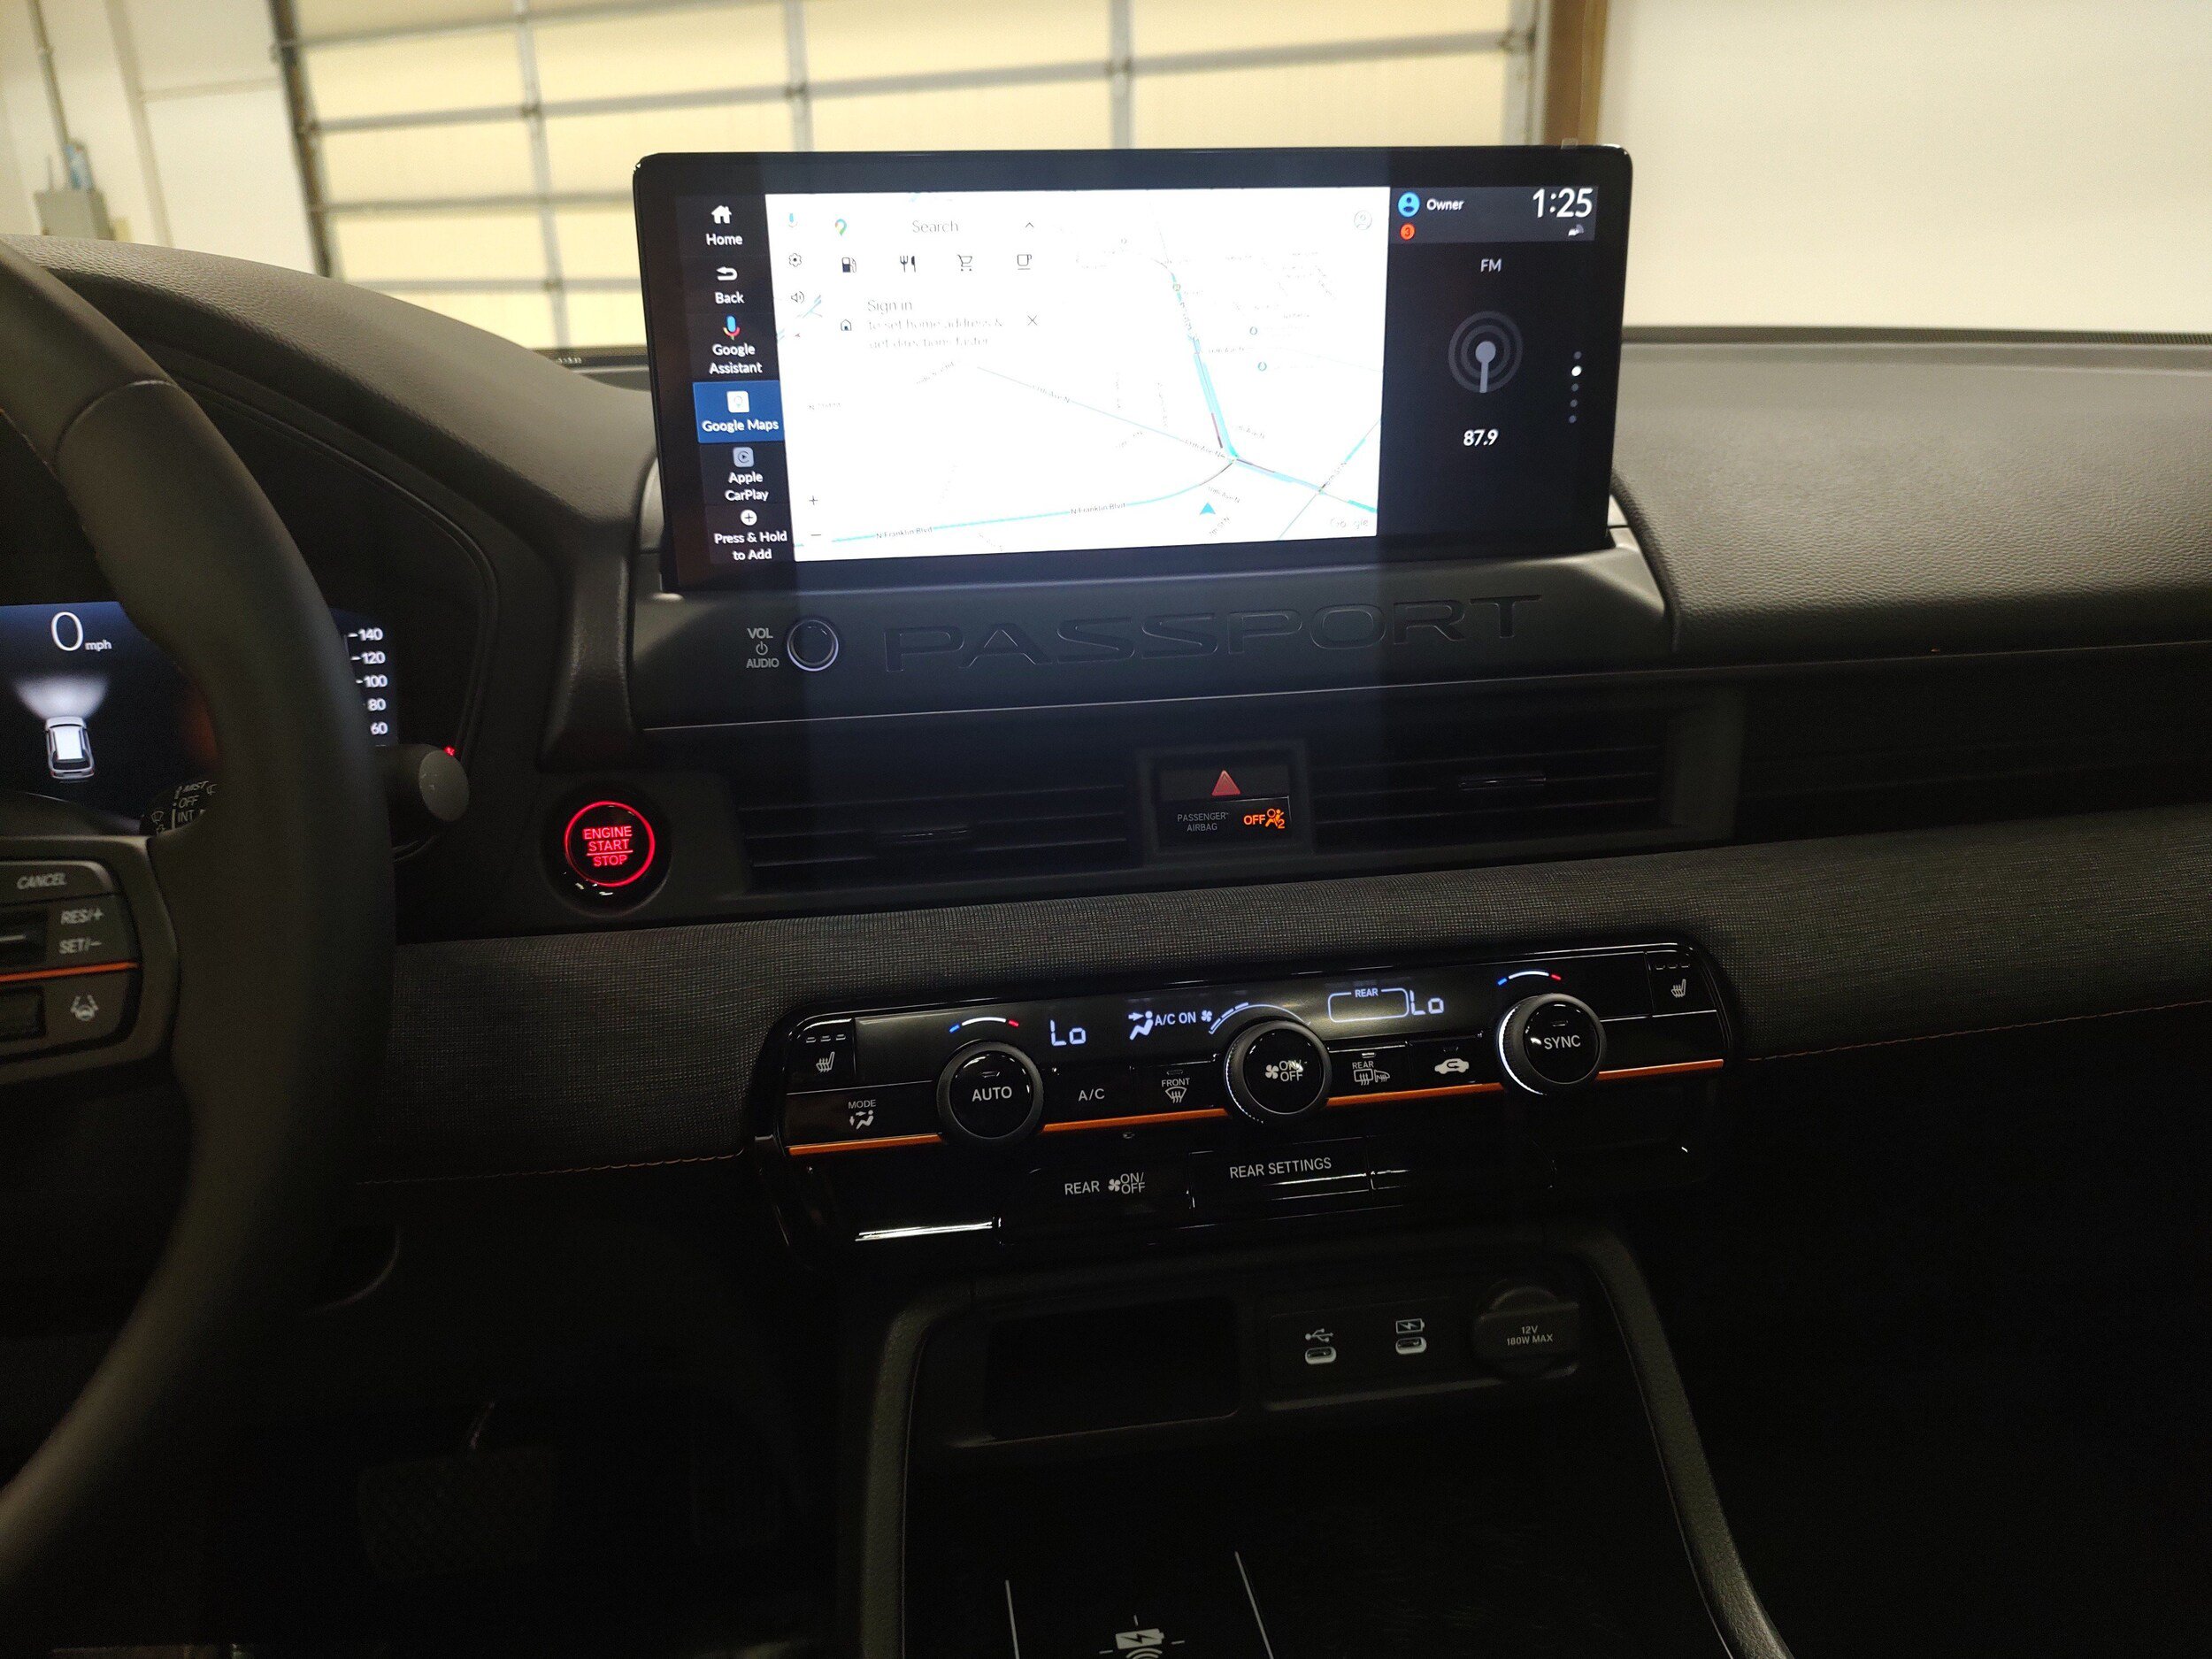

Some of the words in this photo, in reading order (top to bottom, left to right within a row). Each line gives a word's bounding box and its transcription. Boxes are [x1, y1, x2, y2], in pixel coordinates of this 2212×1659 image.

[1426, 198, 1466, 212] Owner
[1532, 187, 1594, 219] 1:25
[912, 219, 959, 234] Search
[705, 233, 743, 246] Home
[1479, 258, 1502, 273] FM
[714, 291, 745, 304] Back
[867, 298, 898, 314] Sign
[901, 299, 913, 311] in
[712, 342, 756, 357] Google
[709, 361, 763, 375] Assistant
[702, 419, 745, 433] Google
[747, 419, 780, 432] Maps
[1463, 428, 1499, 446] 87.9
[728, 471, 764, 484] Apple
[725, 489, 769, 503] CarPlay
[714, 533, 745, 544] Press
[746, 533, 757, 543] &
[759, 530, 787, 542] Hold
[884, 528, 915, 538] Franklin
[732, 549, 745, 560] to
[748, 549, 772, 560] Add
[50, 611, 84, 652] 0
[84, 638, 112, 652] mph
[358, 626, 384, 641] 140
[746, 626, 774, 639] VOL
[883, 594, 1542, 673] PASSPORT
[361, 651, 387, 664] 120
[746, 657, 780, 670] AUDIO
[363, 674, 388, 688] 100
[367, 697, 387, 711] 80
[370, 721, 388, 735] 60
[178, 795, 201, 810] OFF
[177, 809, 196, 824] INT
[1177, 810, 1228, 823] PASSENGER
[1242, 812, 1267, 826] OFF
[582, 825, 634, 841] ENGINE
[1187, 823, 1218, 833] AIRBAG
[588, 838, 630, 853] START
[592, 853, 628, 868] STOP
[16, 872, 67, 890] CANCEL
[1354, 987, 1379, 999] REAR
[1409, 988, 1445, 1017] Lo
[1154, 1013, 1176, 1026] A/C
[1178, 1010, 1197, 1025] ON
[1049, 1018, 1087, 1048] Lo
[1543, 1033, 1582, 1051] SYNC
[1351, 1060, 1375, 1070] REAR
[1160, 1076, 1191, 1088] FRONT
[1279, 1071, 1303, 1082] OFF
[972, 1085, 1013, 1103] AUTO
[1078, 1087, 1106, 1102] A/C
[847, 1099, 877, 1110] MODE
[1228, 1163, 1265, 1179] REAR
[1268, 1156, 1333, 1175] SETTINGS
[1064, 1179, 1101, 1196] REAR
[1119, 1171, 1145, 1184] ON/
[1120, 1182, 1146, 1194] OFF
[1521, 1325, 1539, 1334] 12V
[1506, 1335, 1531, 1346] 180W
[1532, 1333, 1554, 1344] MAX
